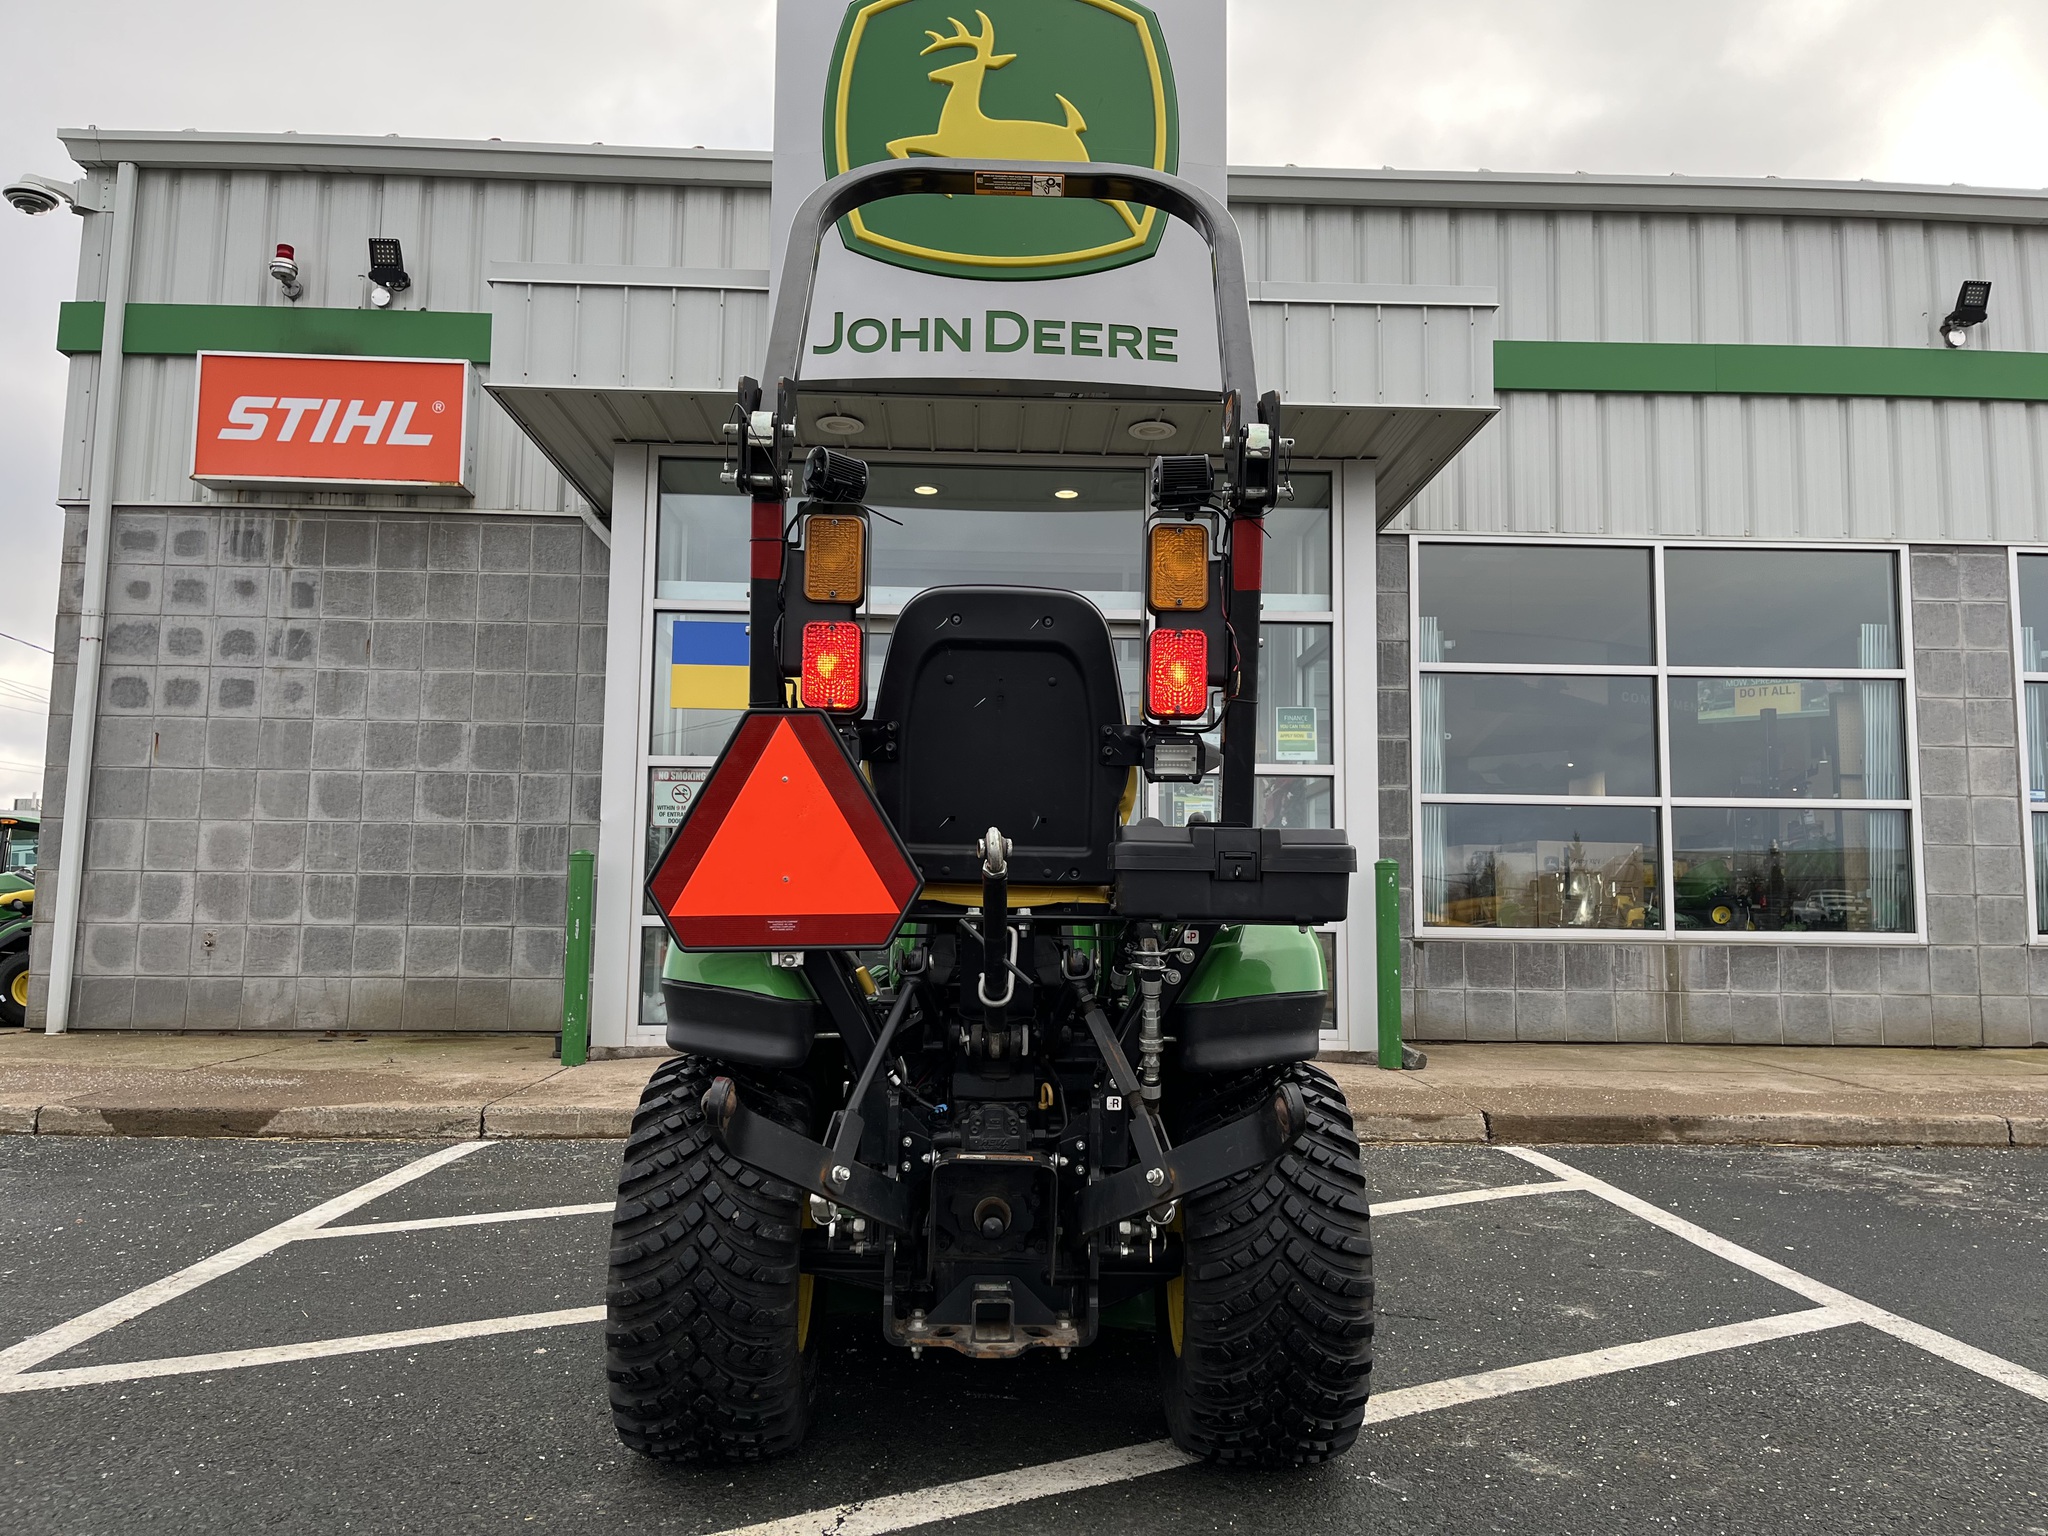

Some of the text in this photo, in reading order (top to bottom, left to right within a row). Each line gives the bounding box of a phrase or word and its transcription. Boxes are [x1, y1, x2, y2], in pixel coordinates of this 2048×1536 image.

[813, 310, 1178, 363] JOHN DEERE
[217, 396, 433, 446] STIHL
[1740, 686, 1796, 698] DO IT ALL.
[658, 771, 706, 780] NO SMOKING
